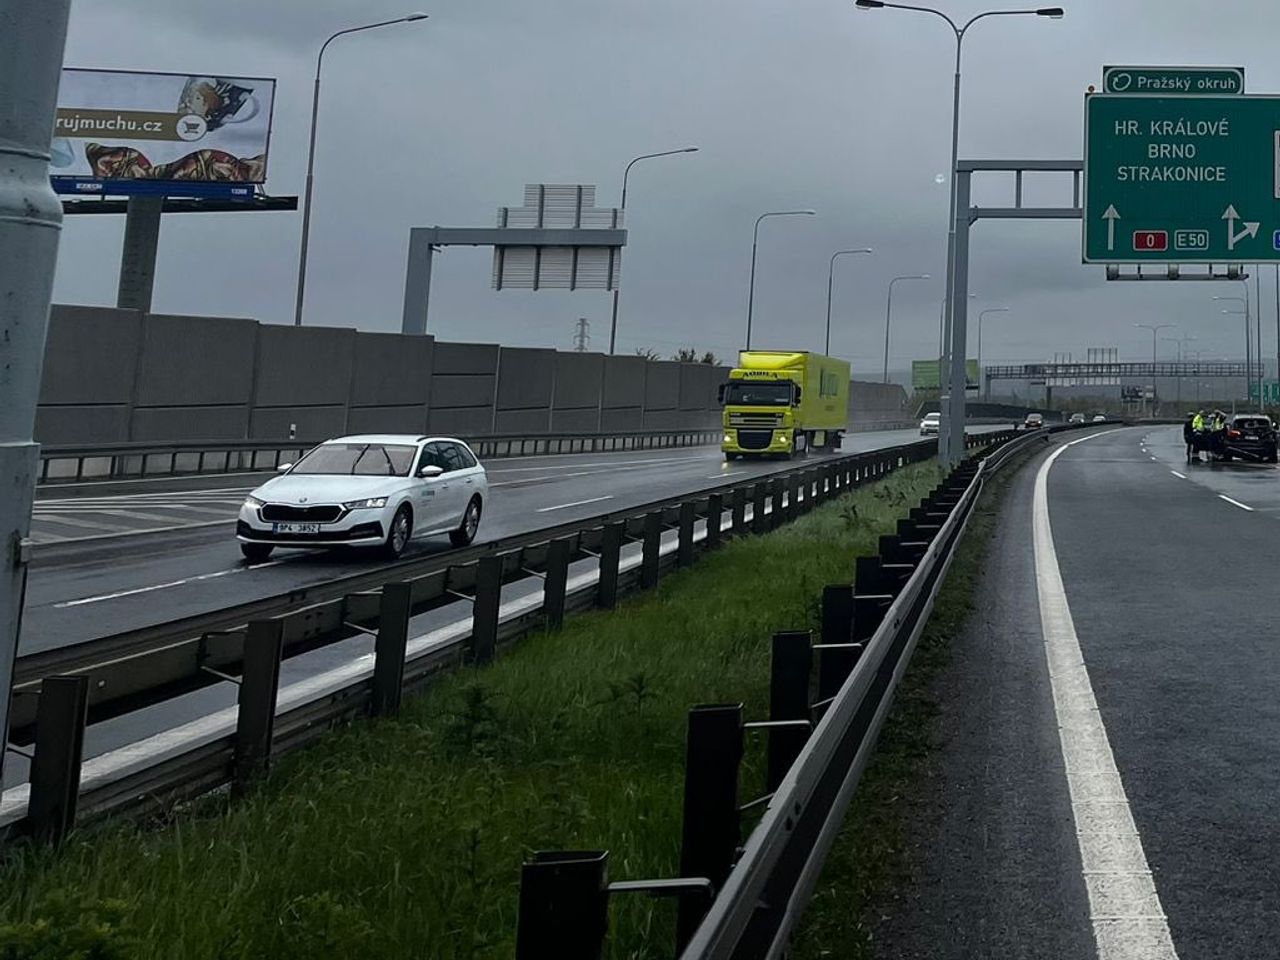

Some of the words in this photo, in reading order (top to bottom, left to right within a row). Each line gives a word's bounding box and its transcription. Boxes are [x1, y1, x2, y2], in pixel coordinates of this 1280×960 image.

[1137, 76, 1191, 91] Pražský
[1197, 78, 1236, 89] okruh
[56, 115, 163, 132] rujmuchu.cz
[1114, 120, 1143, 136] HR.
[1151, 117, 1229, 136] KRÁLOVÉ
[1148, 143, 1196, 159] BRNO
[1117, 166, 1226, 182] STRAKONICE
[1146, 234, 1155, 247] 0
